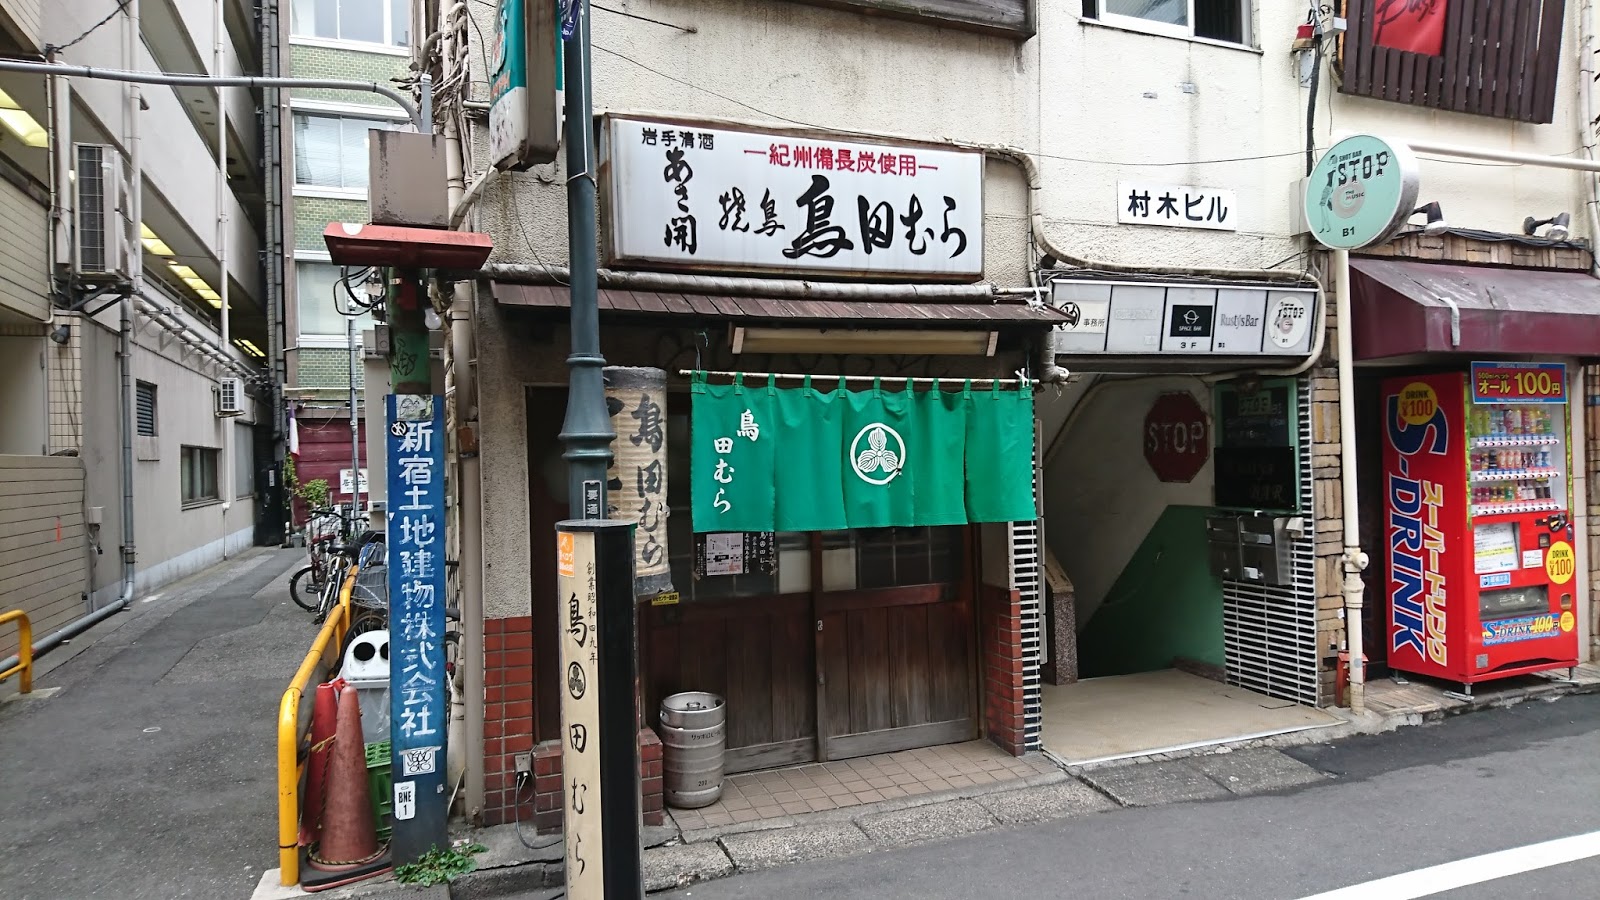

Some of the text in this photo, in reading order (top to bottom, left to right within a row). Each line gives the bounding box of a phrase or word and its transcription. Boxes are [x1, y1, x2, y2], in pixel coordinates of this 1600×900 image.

[641, 127, 715, 151] 岩手清酒
[1337, 150, 1391, 187] STOP
[663, 146, 698, 256] あさ開
[1127, 188, 1228, 224] 村木ビル
[1345, 191, 1365, 201] MUSIC
[1342, 226, 1355, 238] B1
[1083, 318, 1106, 328] 事務所
[1245, 314, 1260, 327] Bar
[1281, 307, 1305, 319] STOP
[1405, 389, 1429, 400] DRINK
[1478, 371, 1561, 395] オール 100円
[1148, 421, 1205, 456] STOP
[712, 408, 760, 514] 鳥田むら
[586, 489, 599, 520] 要通
[1552, 549, 1569, 559] DRINK
[398, 420, 437, 737] 新宿土地建物株式会社
[1422, 480, 1448, 667] スーパードリンク
[398, 790, 412, 804] BNE
[403, 804, 408, 816] 1
